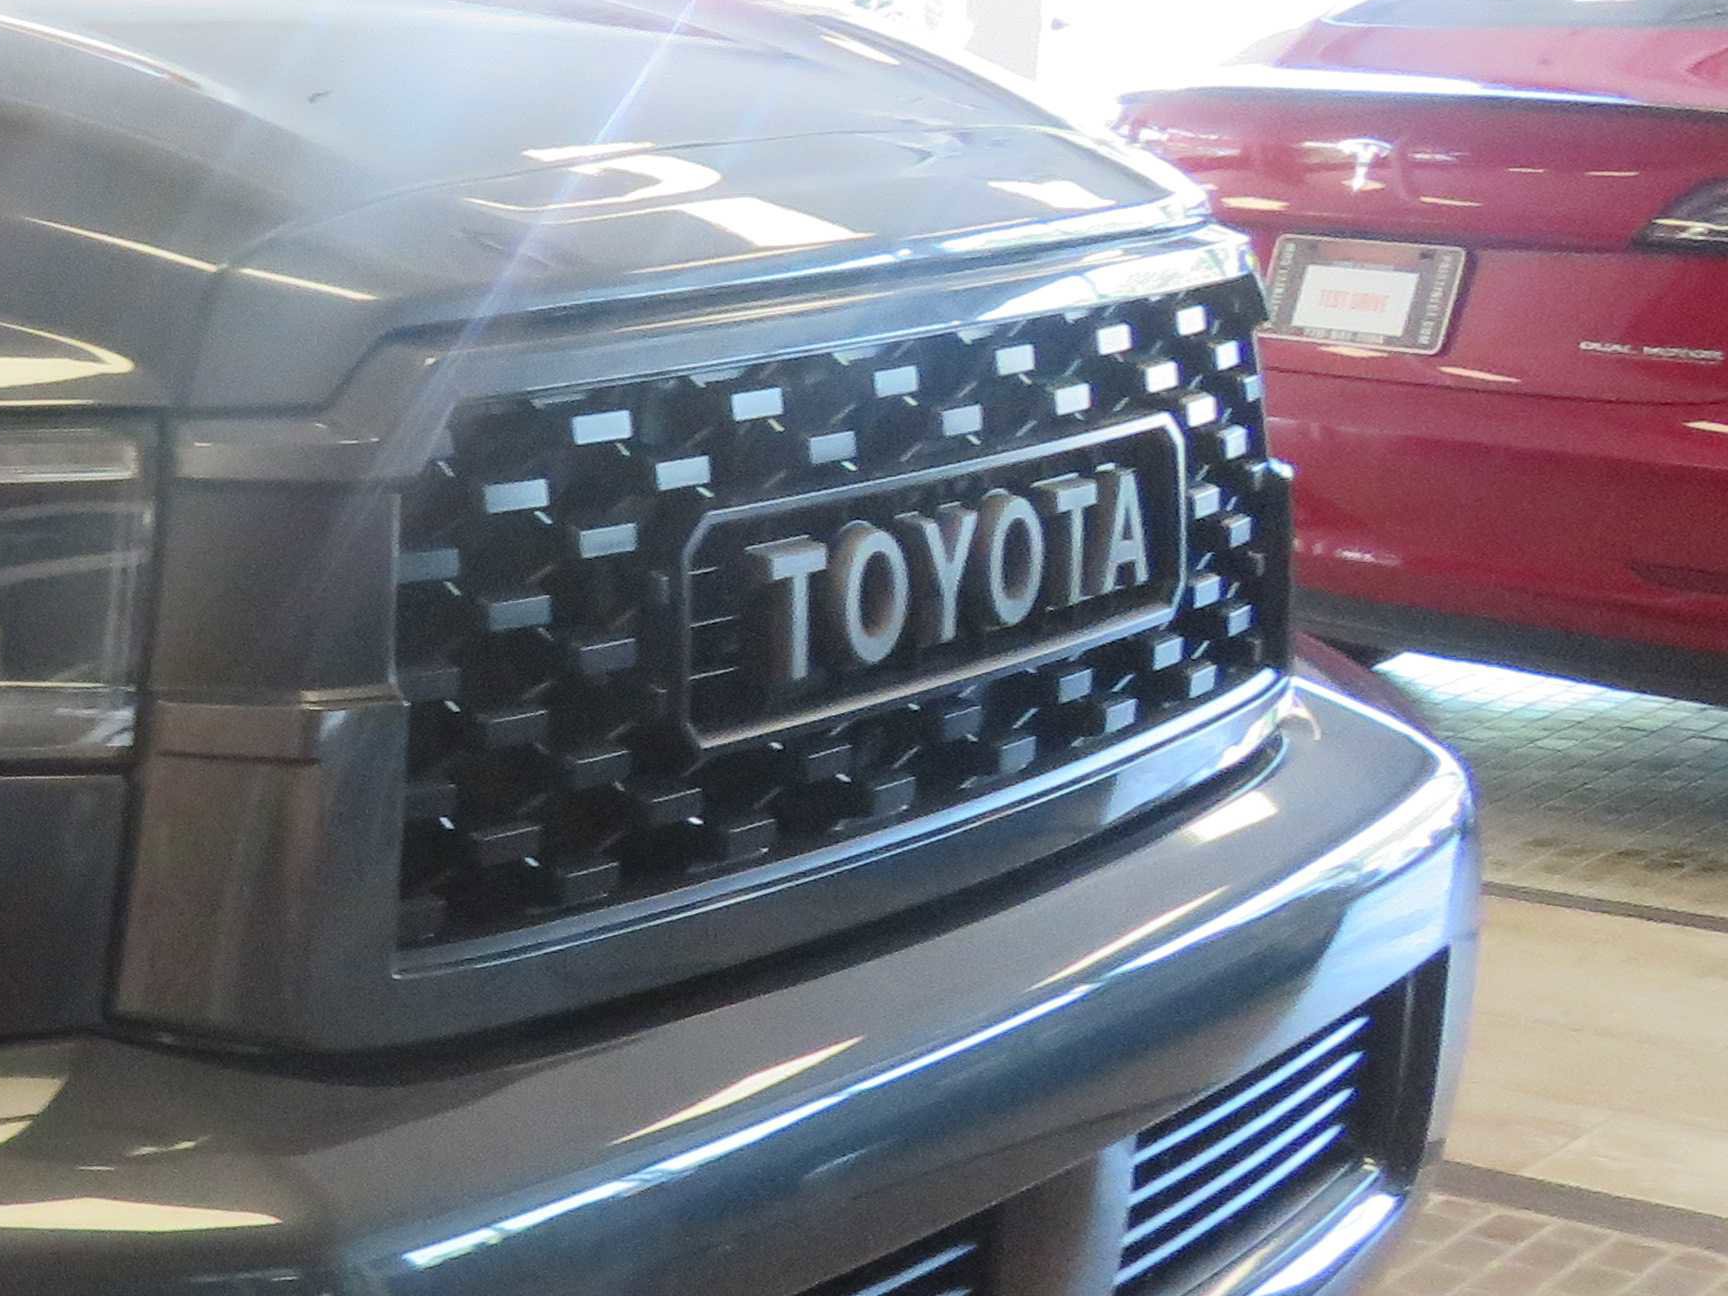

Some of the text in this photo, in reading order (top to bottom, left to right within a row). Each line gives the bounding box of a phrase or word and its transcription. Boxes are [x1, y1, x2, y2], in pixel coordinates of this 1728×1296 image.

[1578, 340, 1725, 360] DUAL MOTOR
[747, 463, 1150, 681] TOYOTA
